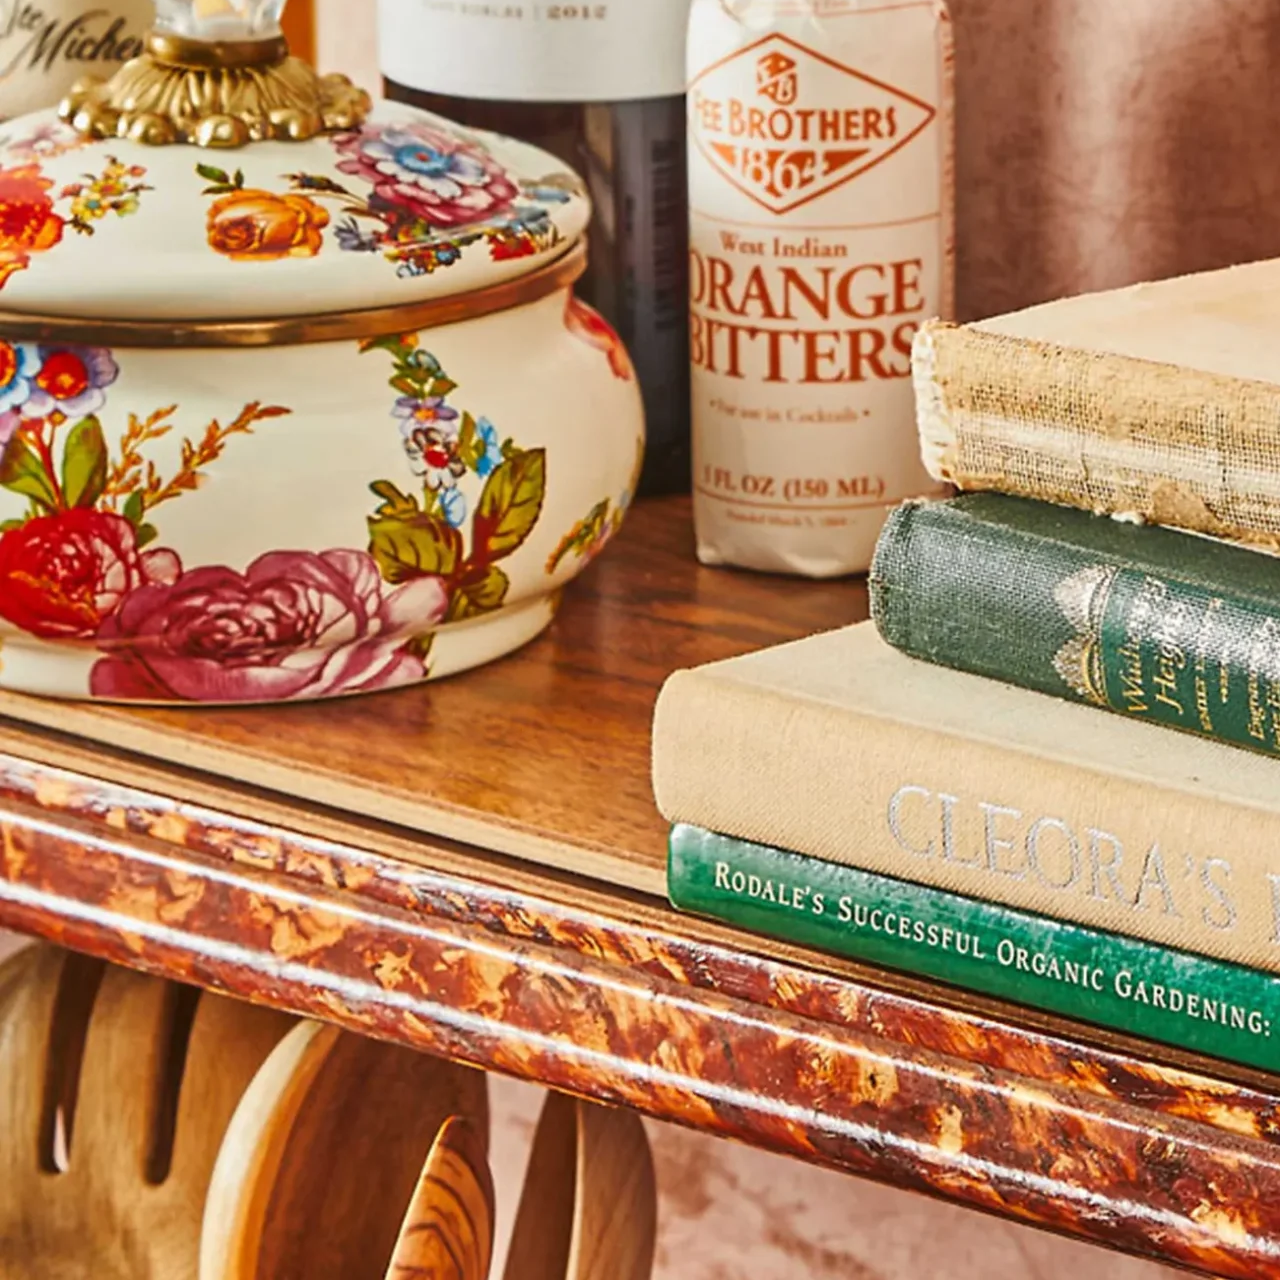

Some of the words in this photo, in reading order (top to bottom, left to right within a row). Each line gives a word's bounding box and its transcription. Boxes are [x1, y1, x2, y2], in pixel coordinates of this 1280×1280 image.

[728, 98, 898, 142] BROTHERS
[720, 231, 765, 256] West
[773, 237, 848, 258] Indian
[887, 784, 1237, 931] CLEORA'S
